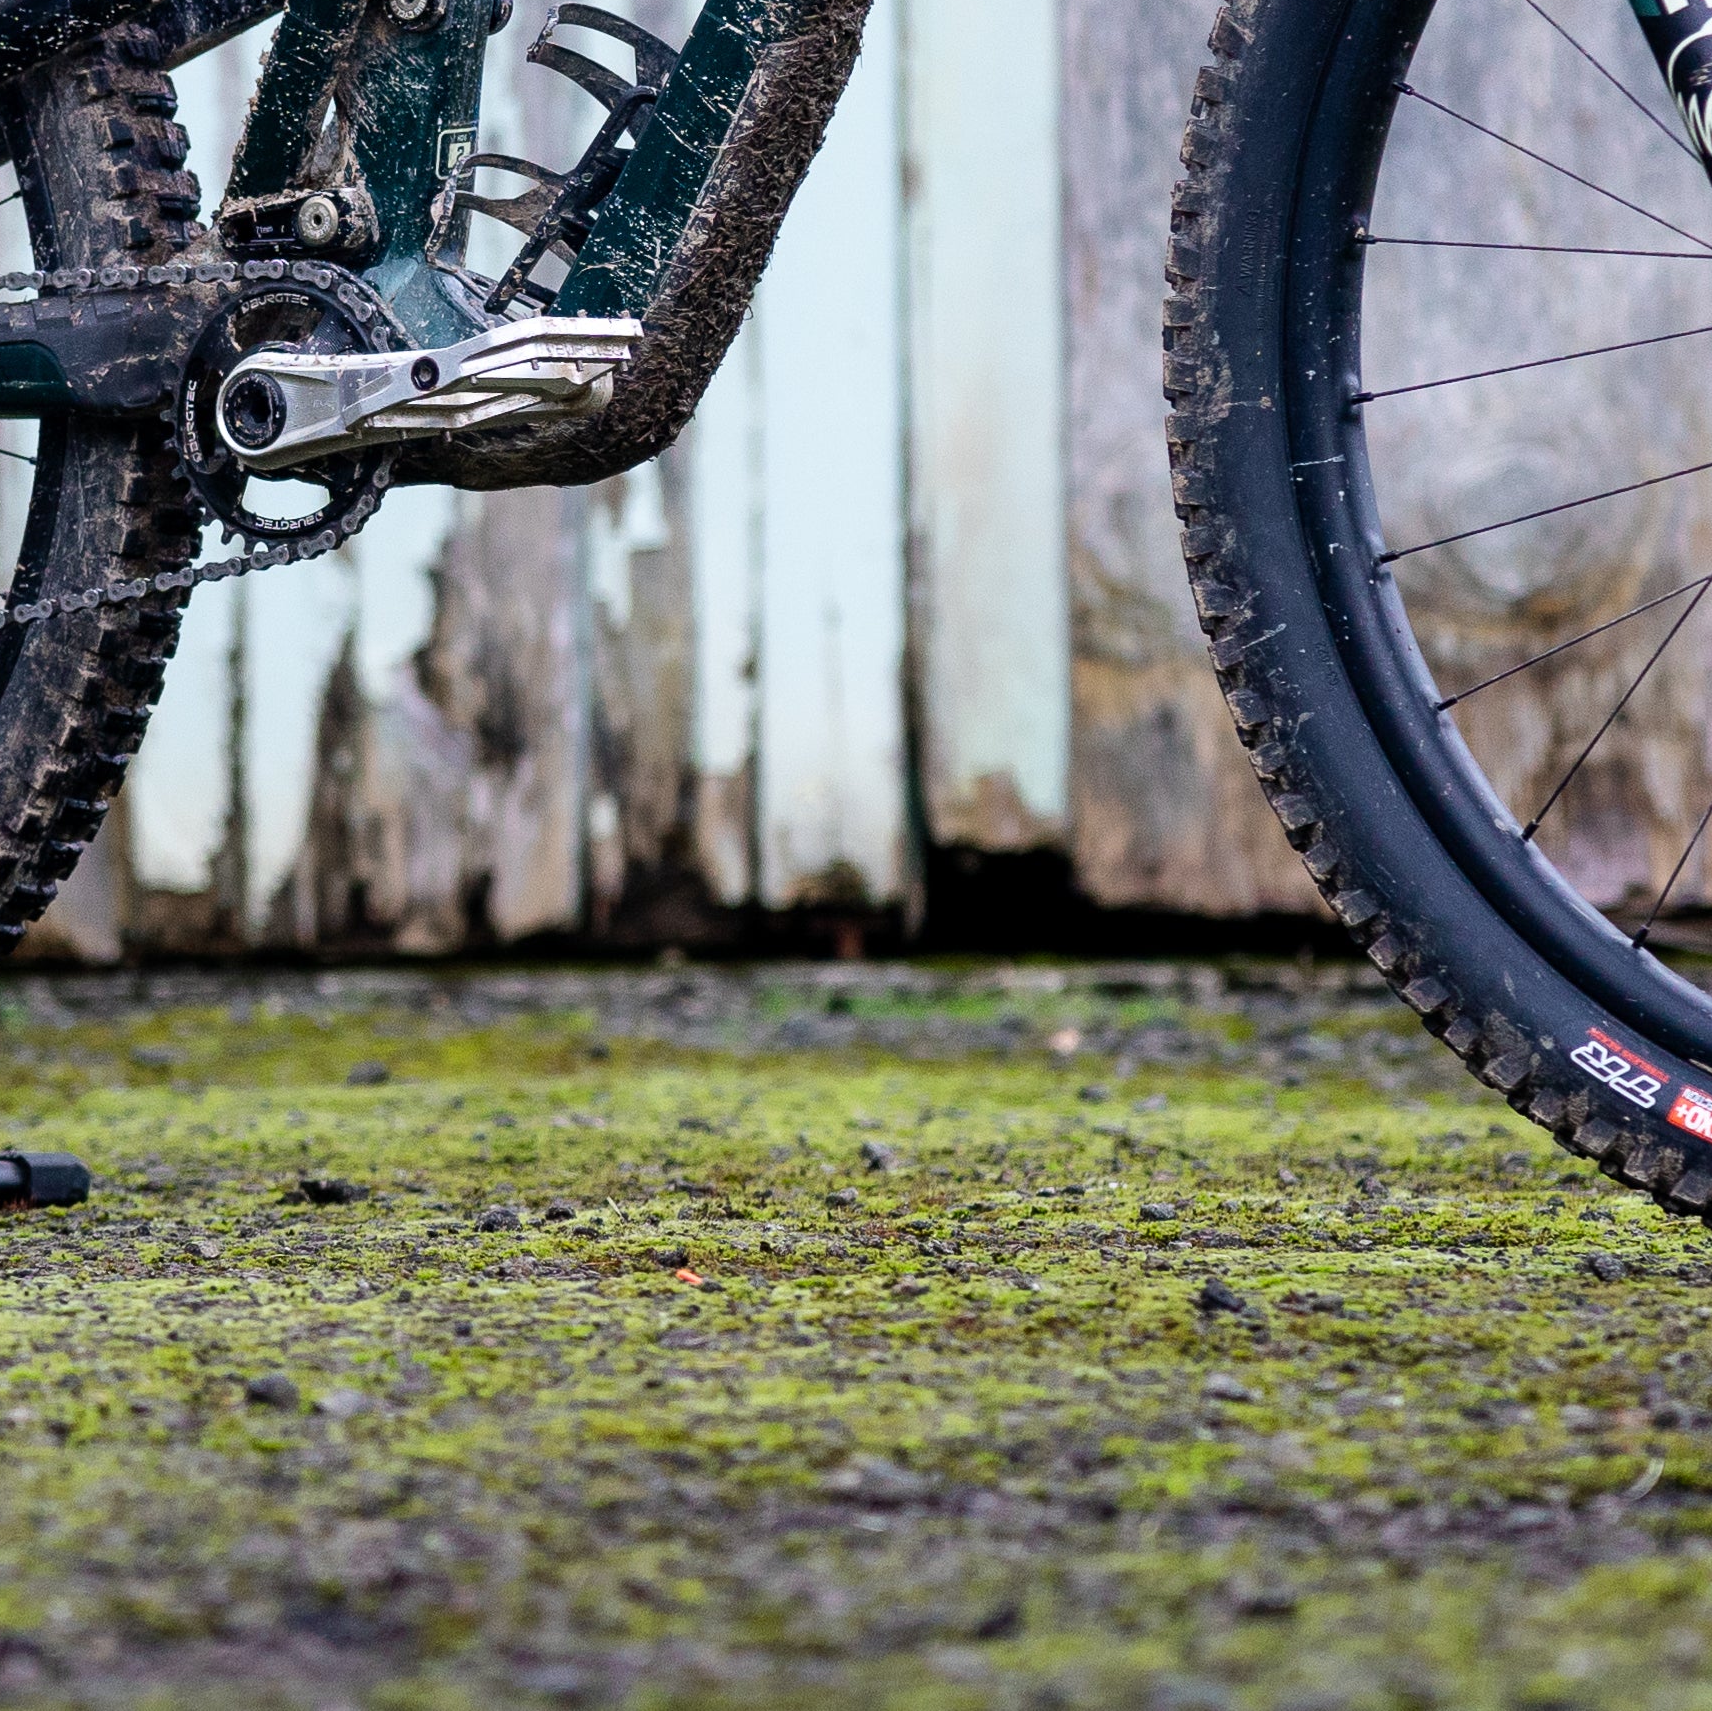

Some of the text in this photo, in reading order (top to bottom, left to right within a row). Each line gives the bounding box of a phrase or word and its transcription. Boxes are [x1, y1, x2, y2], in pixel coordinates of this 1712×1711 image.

[250, 292, 310, 309] BURGTEC
[185, 379, 201, 453] BURGTEC
[255, 515, 317, 531] BURGTEC
[1570, 1040, 1661, 1109] TR
